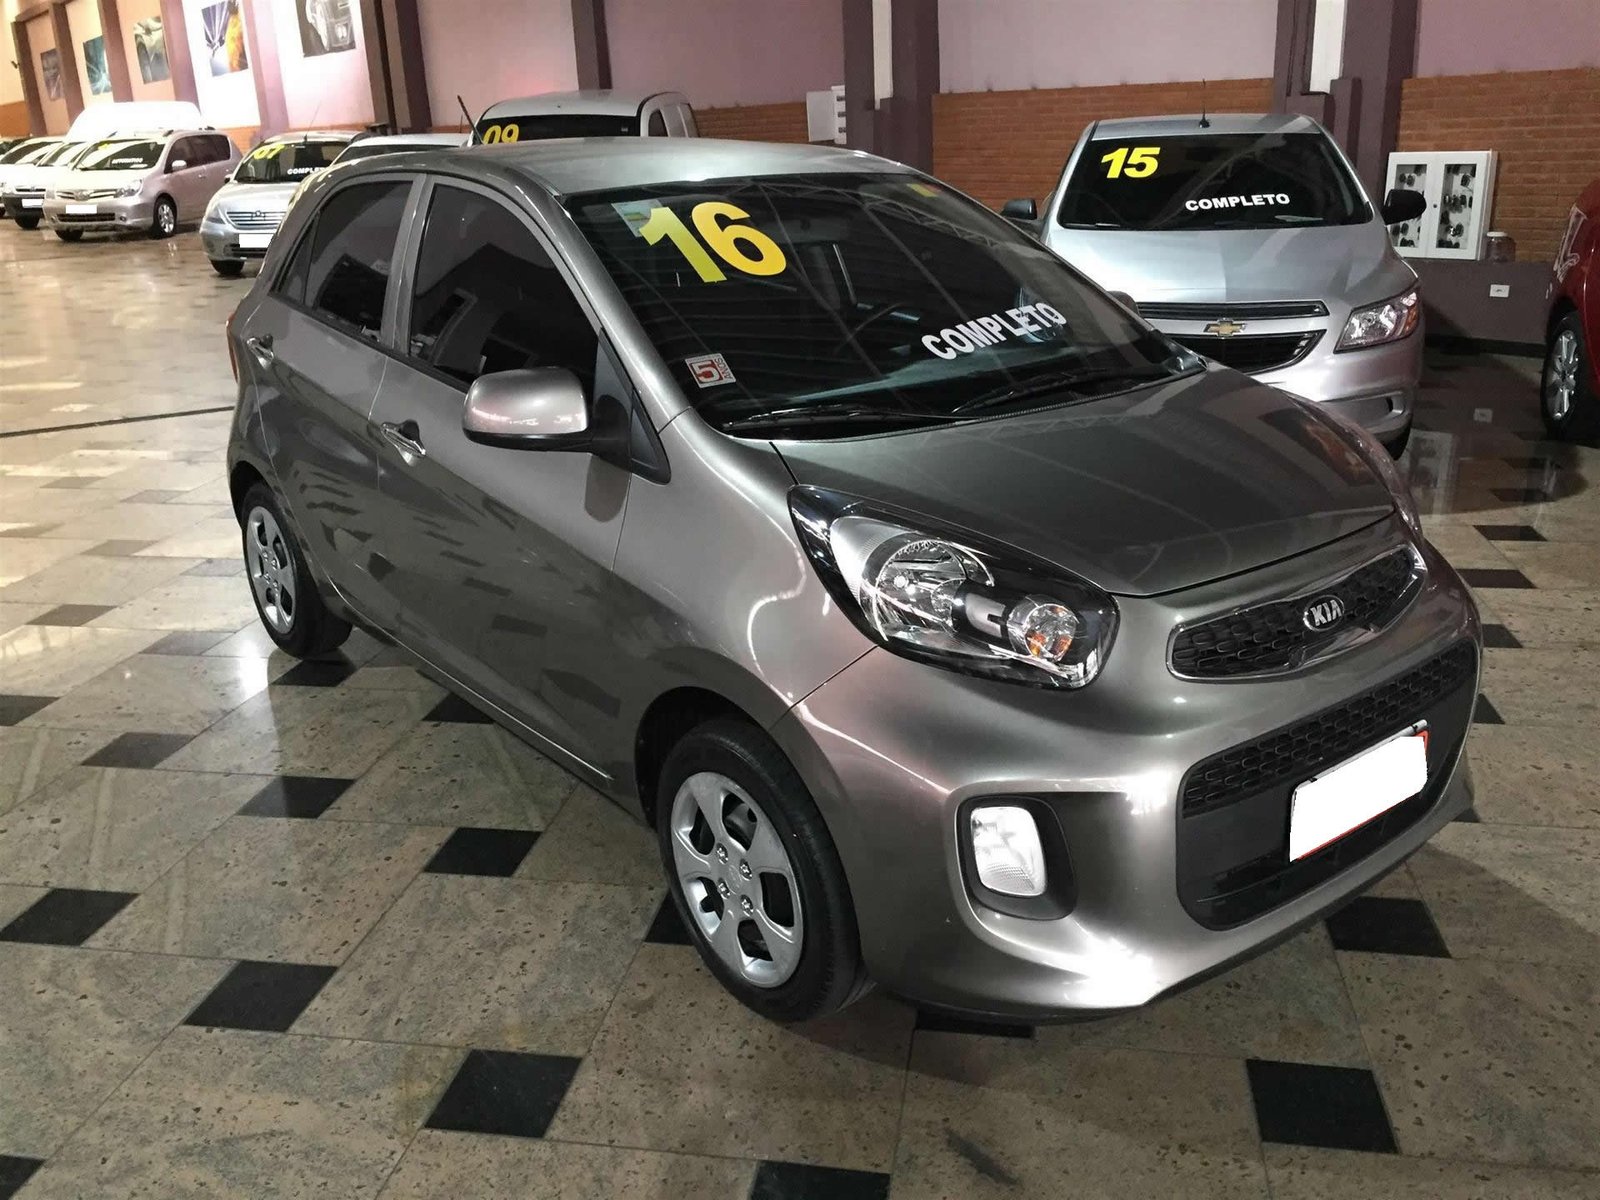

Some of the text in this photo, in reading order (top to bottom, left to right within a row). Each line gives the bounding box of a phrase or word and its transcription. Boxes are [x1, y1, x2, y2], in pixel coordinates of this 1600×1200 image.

[483, 124, 519, 145] 09
[1101, 147, 1160, 179] 15
[1185, 193, 1290, 211] COMPLETO
[639, 202, 787, 283] 16
[921, 302, 1068, 360] COMPLETO
[691, 361, 720, 383] 5
[1310, 600, 1342, 627] KIA
